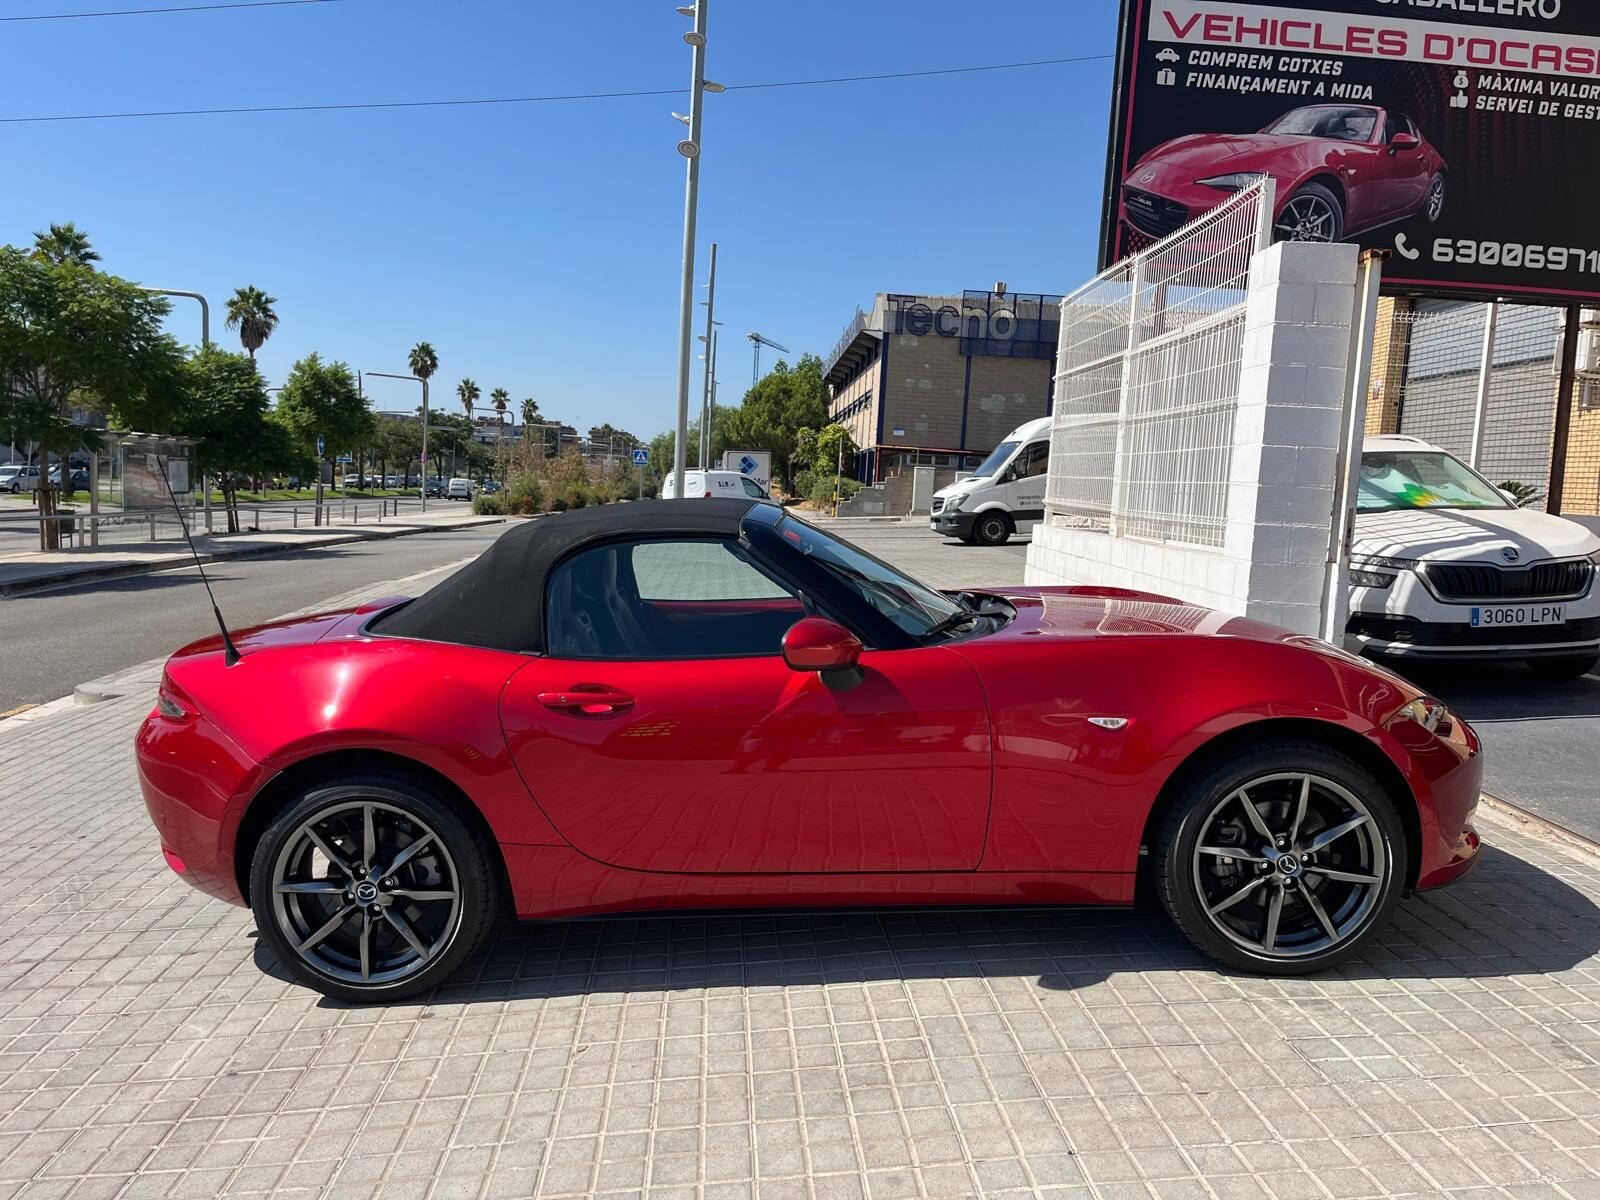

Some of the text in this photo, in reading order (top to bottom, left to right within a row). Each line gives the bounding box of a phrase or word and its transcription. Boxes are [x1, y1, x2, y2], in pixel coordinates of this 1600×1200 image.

[1376, 0, 1561, 19] LLERO
[1163, 11, 1408, 56] VEHICLES
[1187, 50, 1344, 76] COMPREM COTXES
[1185, 72, 1373, 100] FINANÇAMENT A MIDA
[1477, 73, 1600, 99] MÀXIMA VALOR
[1475, 95, 1533, 114] SERVEI
[1538, 101, 1560, 116] DE
[887, 293, 1018, 340] Tecno
[1484, 606, 1561, 624] 3060 LPN
